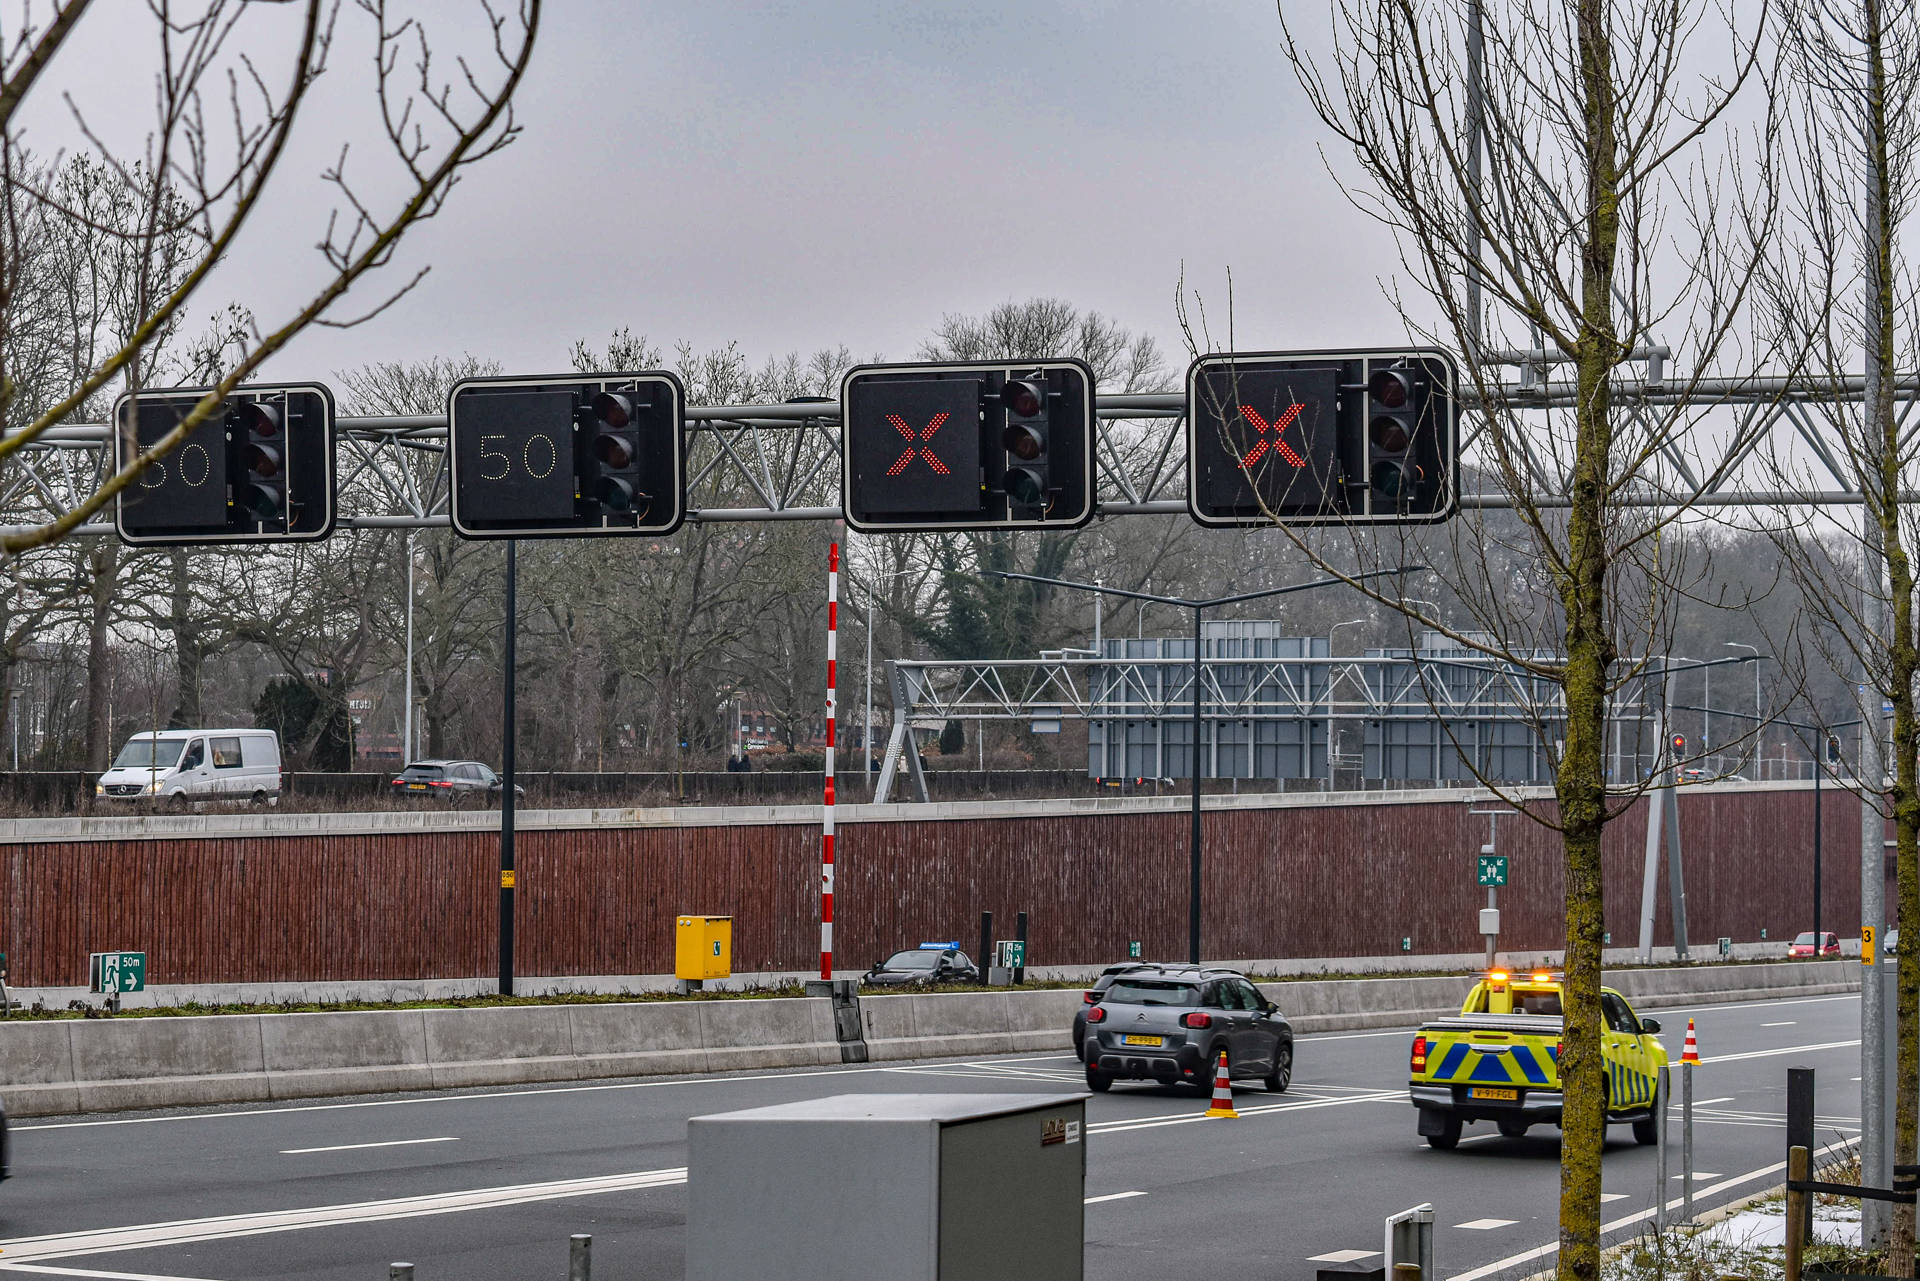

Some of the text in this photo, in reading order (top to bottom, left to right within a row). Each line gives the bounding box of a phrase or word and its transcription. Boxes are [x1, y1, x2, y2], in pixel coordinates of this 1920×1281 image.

[481, 434, 556, 480] 50
[139, 443, 209, 488] 50
[1861, 929, 1872, 943] 3
[123, 957, 140, 967] 50m
[1477, 1089, 1513, 1099] V-91-FGL
